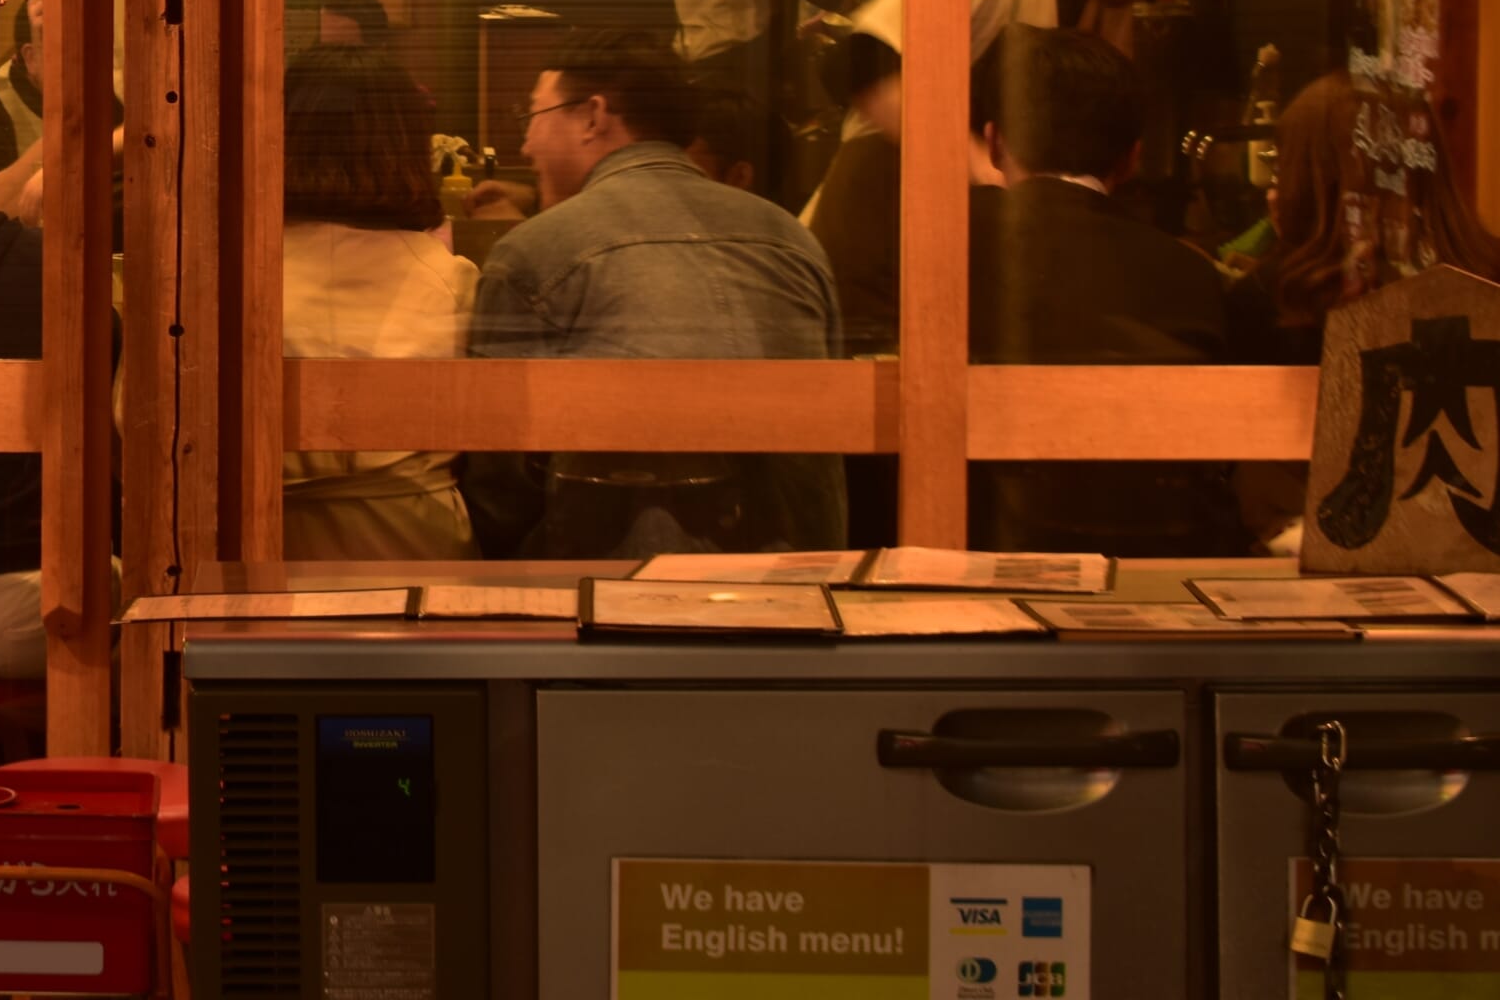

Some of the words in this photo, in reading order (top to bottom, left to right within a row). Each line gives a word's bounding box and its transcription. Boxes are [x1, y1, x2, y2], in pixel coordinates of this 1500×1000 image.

[661, 883, 714, 911] We
[725, 883, 805, 912] have
[1403, 881, 1486, 911] have
[957, 907, 1003, 927] VISA
[660, 923, 789, 957] English
[799, 927, 905, 956] menu!
[1345, 922, 1470, 957] English
